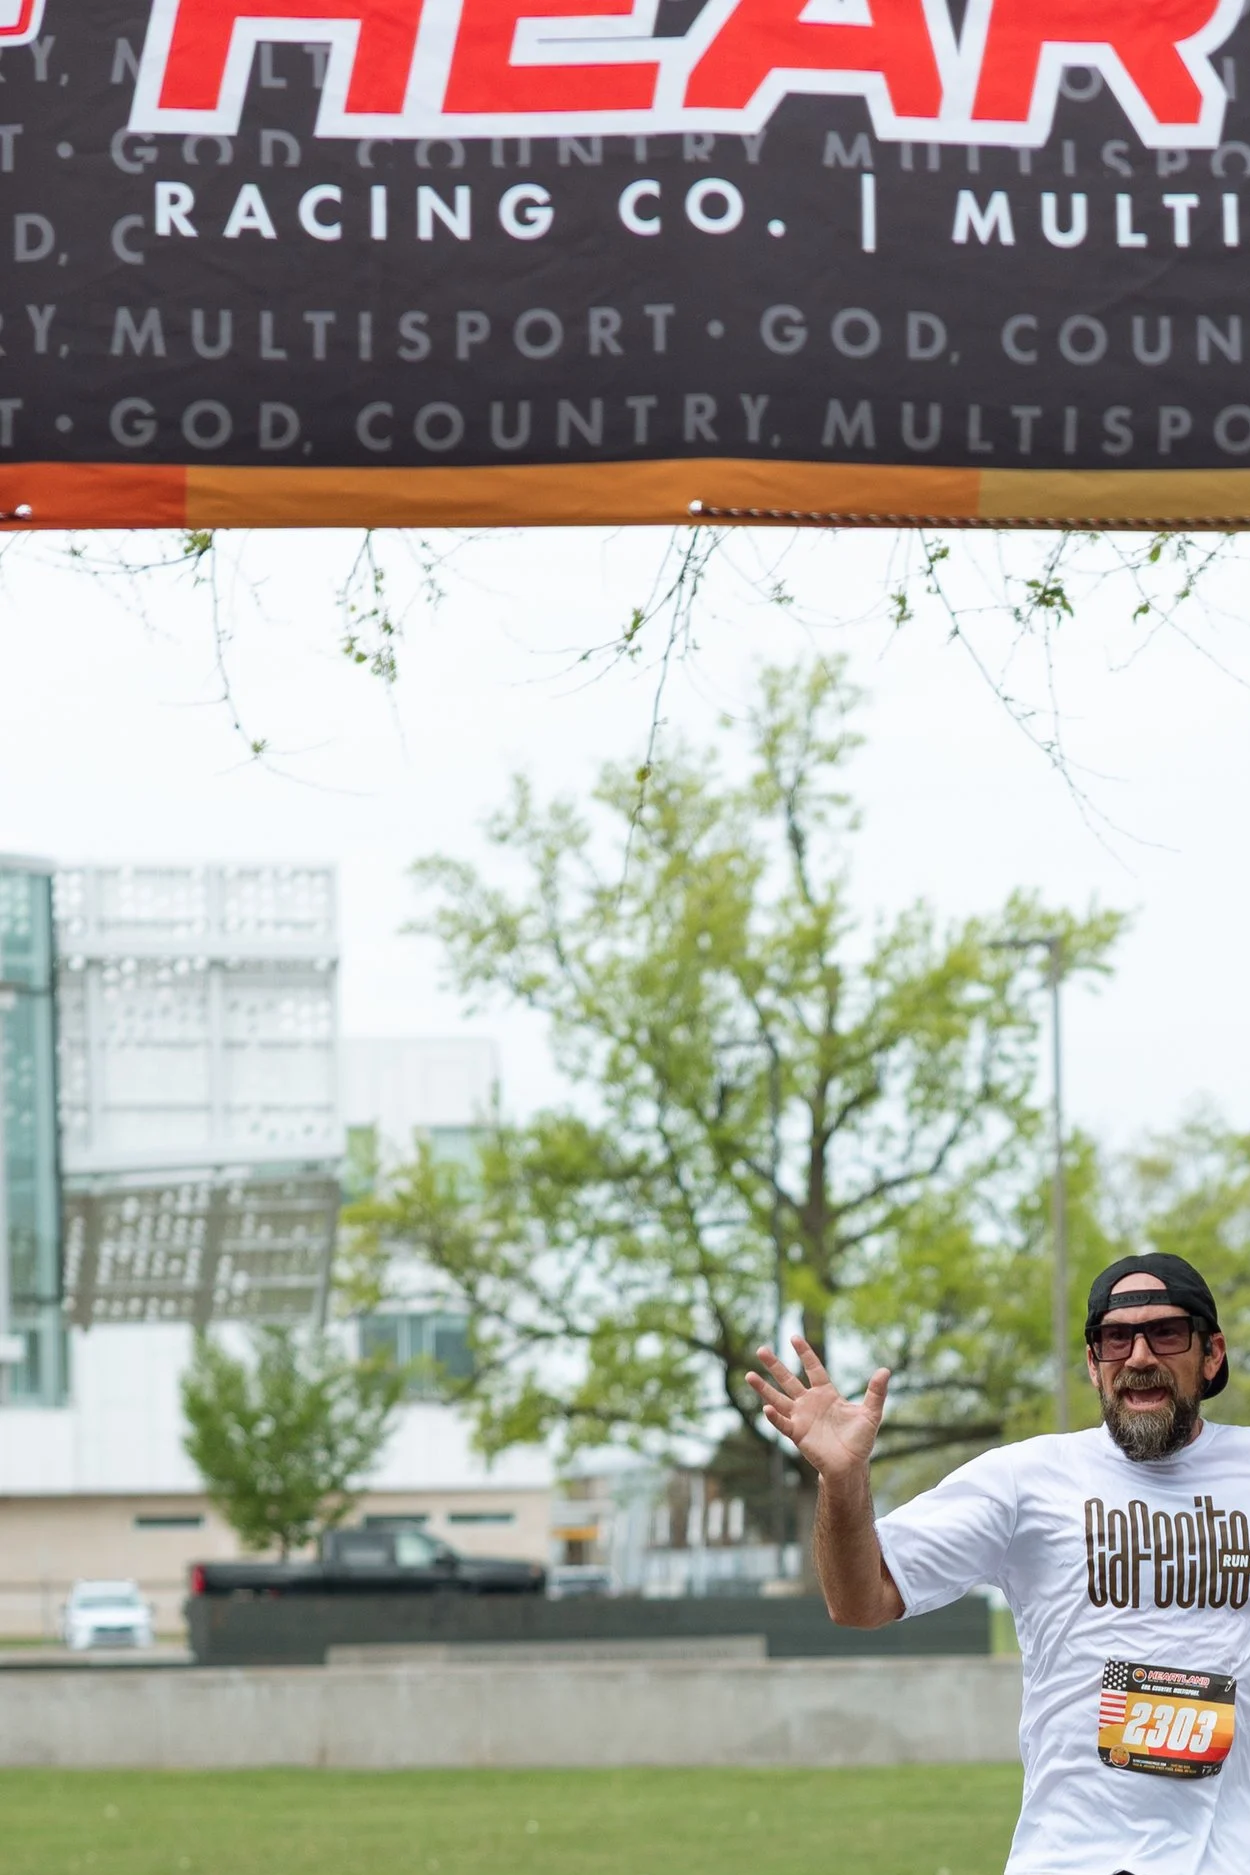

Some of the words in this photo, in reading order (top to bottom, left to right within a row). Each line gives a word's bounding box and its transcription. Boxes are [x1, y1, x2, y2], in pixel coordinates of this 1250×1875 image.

[154, 181, 555, 242] RACING
[617, 177, 788, 238] CO.
[110, 303, 676, 362] MULTISPORT
[759, 304, 961, 365] GOD,
[109, 397, 312, 455] GOD,
[355, 393, 780, 450] COUNTRY,
[1083, 1495, 1250, 1610] Cafecito
[1222, 1554, 1249, 1568] RUN
[1147, 1670, 1211, 1687] HEARTLAND
[1122, 1702, 1218, 1754] 2303
